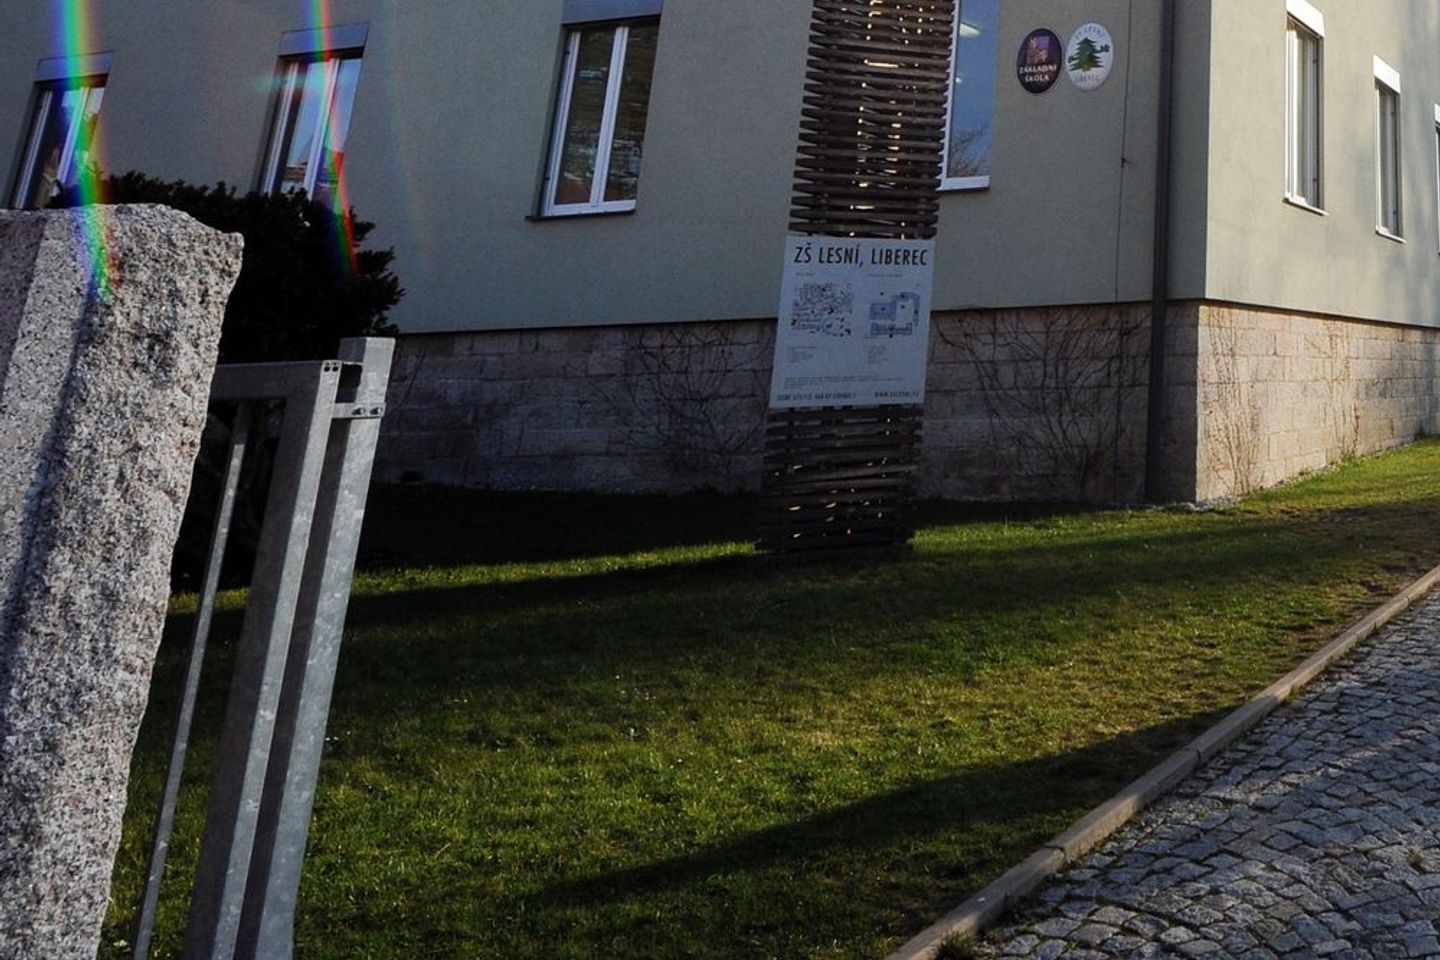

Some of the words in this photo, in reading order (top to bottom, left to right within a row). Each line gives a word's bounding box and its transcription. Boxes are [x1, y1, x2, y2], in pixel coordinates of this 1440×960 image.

[794, 242, 812, 263] ZŠ
[818, 244, 864, 268] LESNÍ,
[871, 248, 928, 266] LIBEREC
